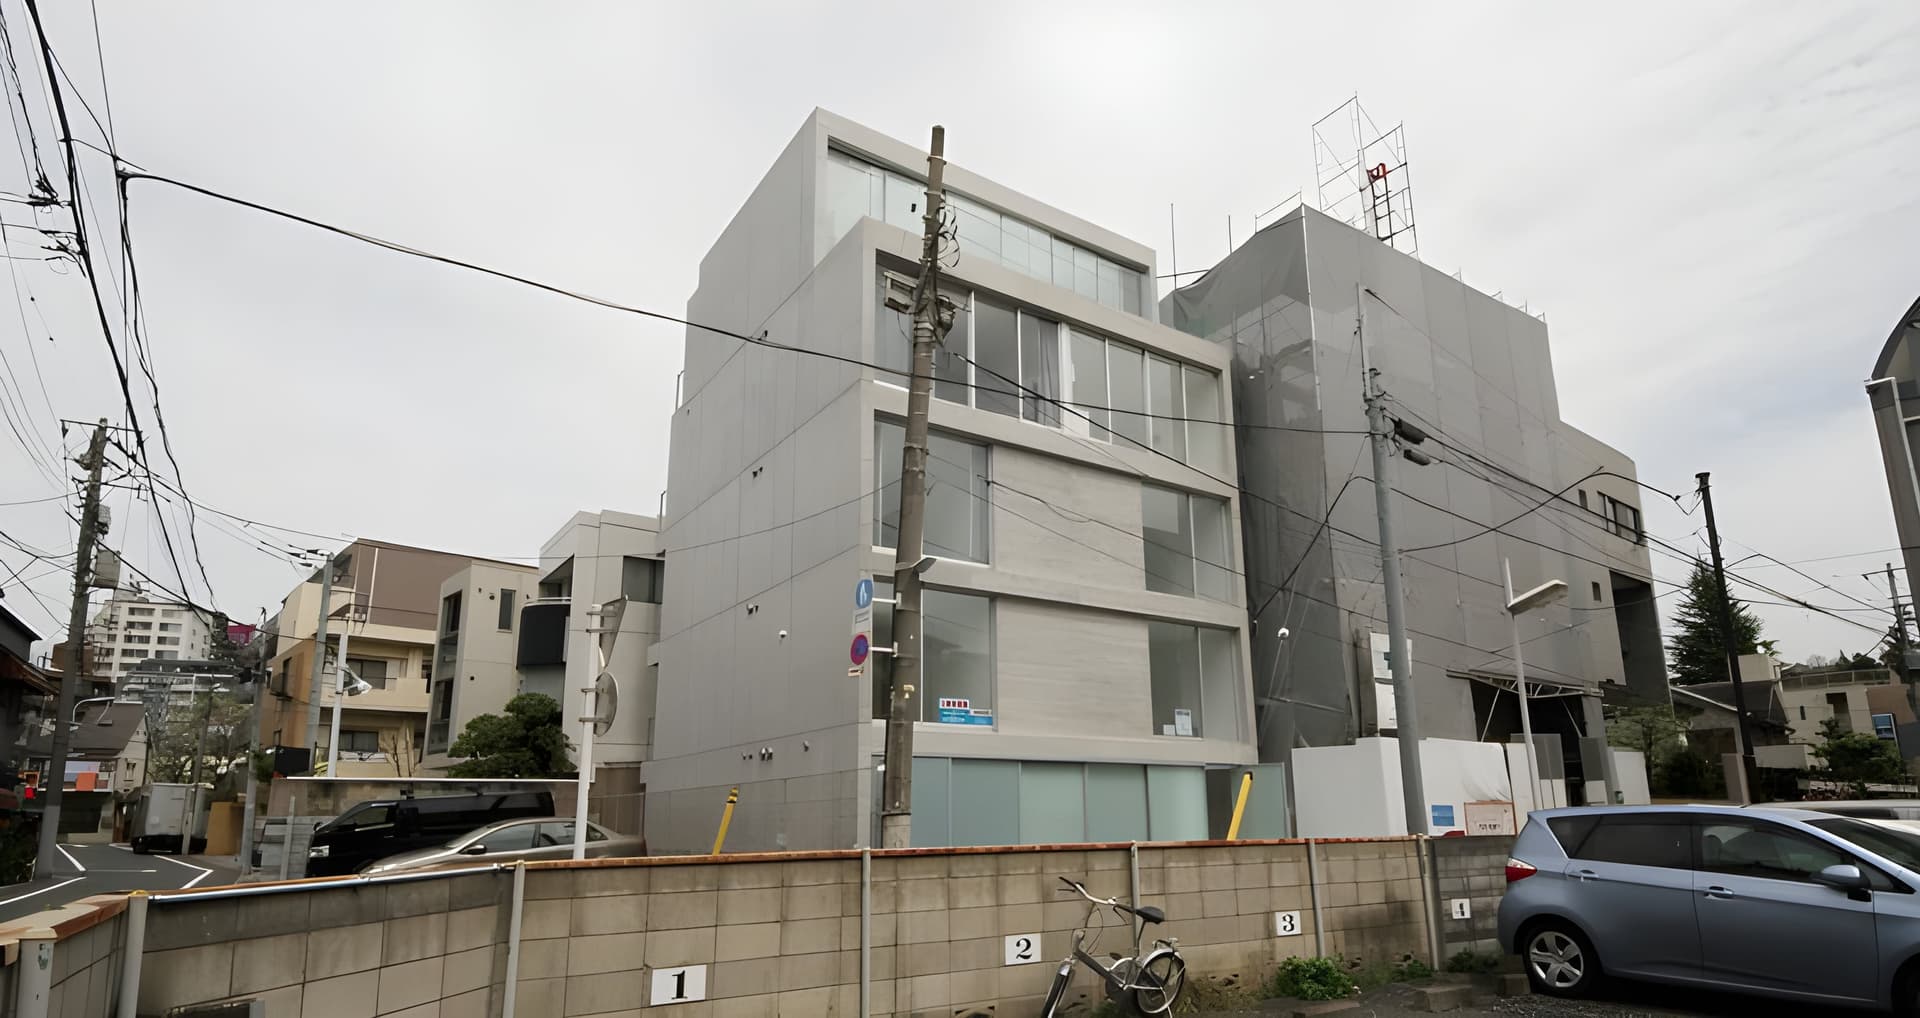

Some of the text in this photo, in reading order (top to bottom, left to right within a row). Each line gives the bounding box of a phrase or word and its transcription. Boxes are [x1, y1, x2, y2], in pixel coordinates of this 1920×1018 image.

[1282, 914, 1295, 932] 3
[1015, 938, 1033, 960] 2
[671, 970, 688, 1000] 1
